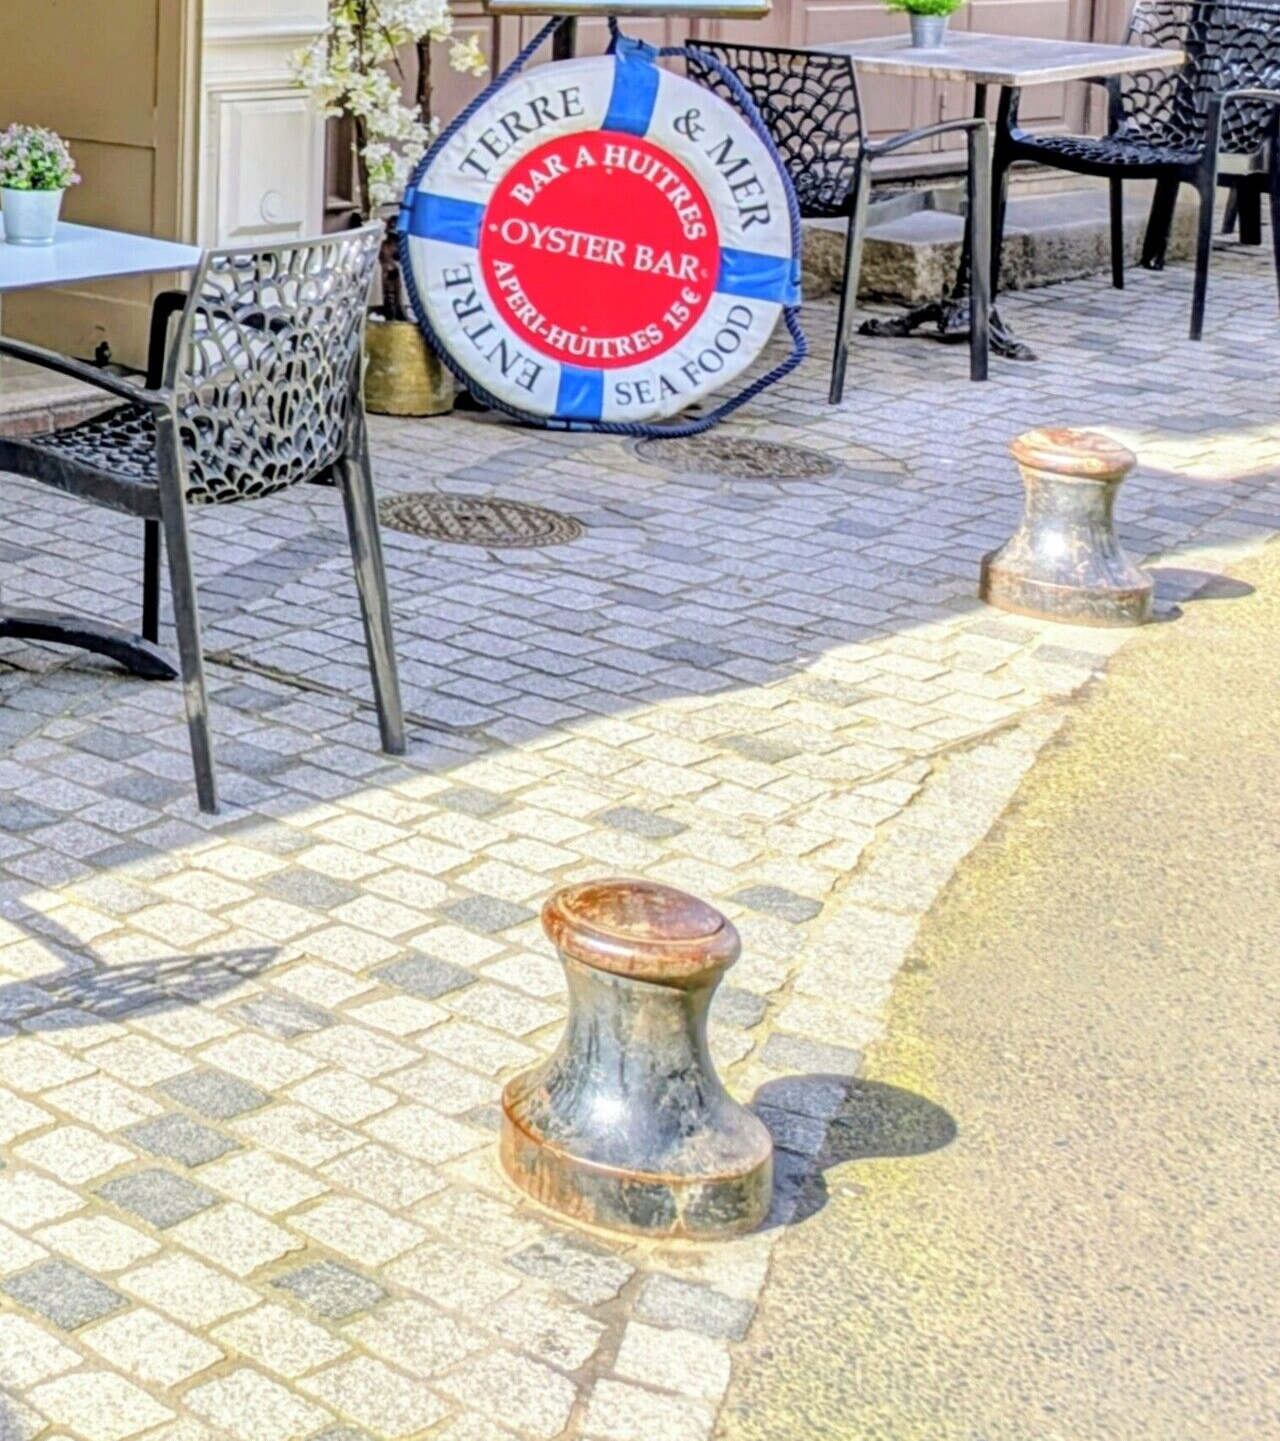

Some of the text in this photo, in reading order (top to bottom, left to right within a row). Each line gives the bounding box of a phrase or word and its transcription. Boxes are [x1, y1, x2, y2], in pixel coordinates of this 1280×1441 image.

[458, 86, 771, 233] TERRE & MER
[511, 144, 707, 241] BAR A HUITRES
[500, 218, 701, 281] OYSTER BAR
[442, 262, 546, 395] ENTRE
[615, 304, 754, 406] SEA FOOD
